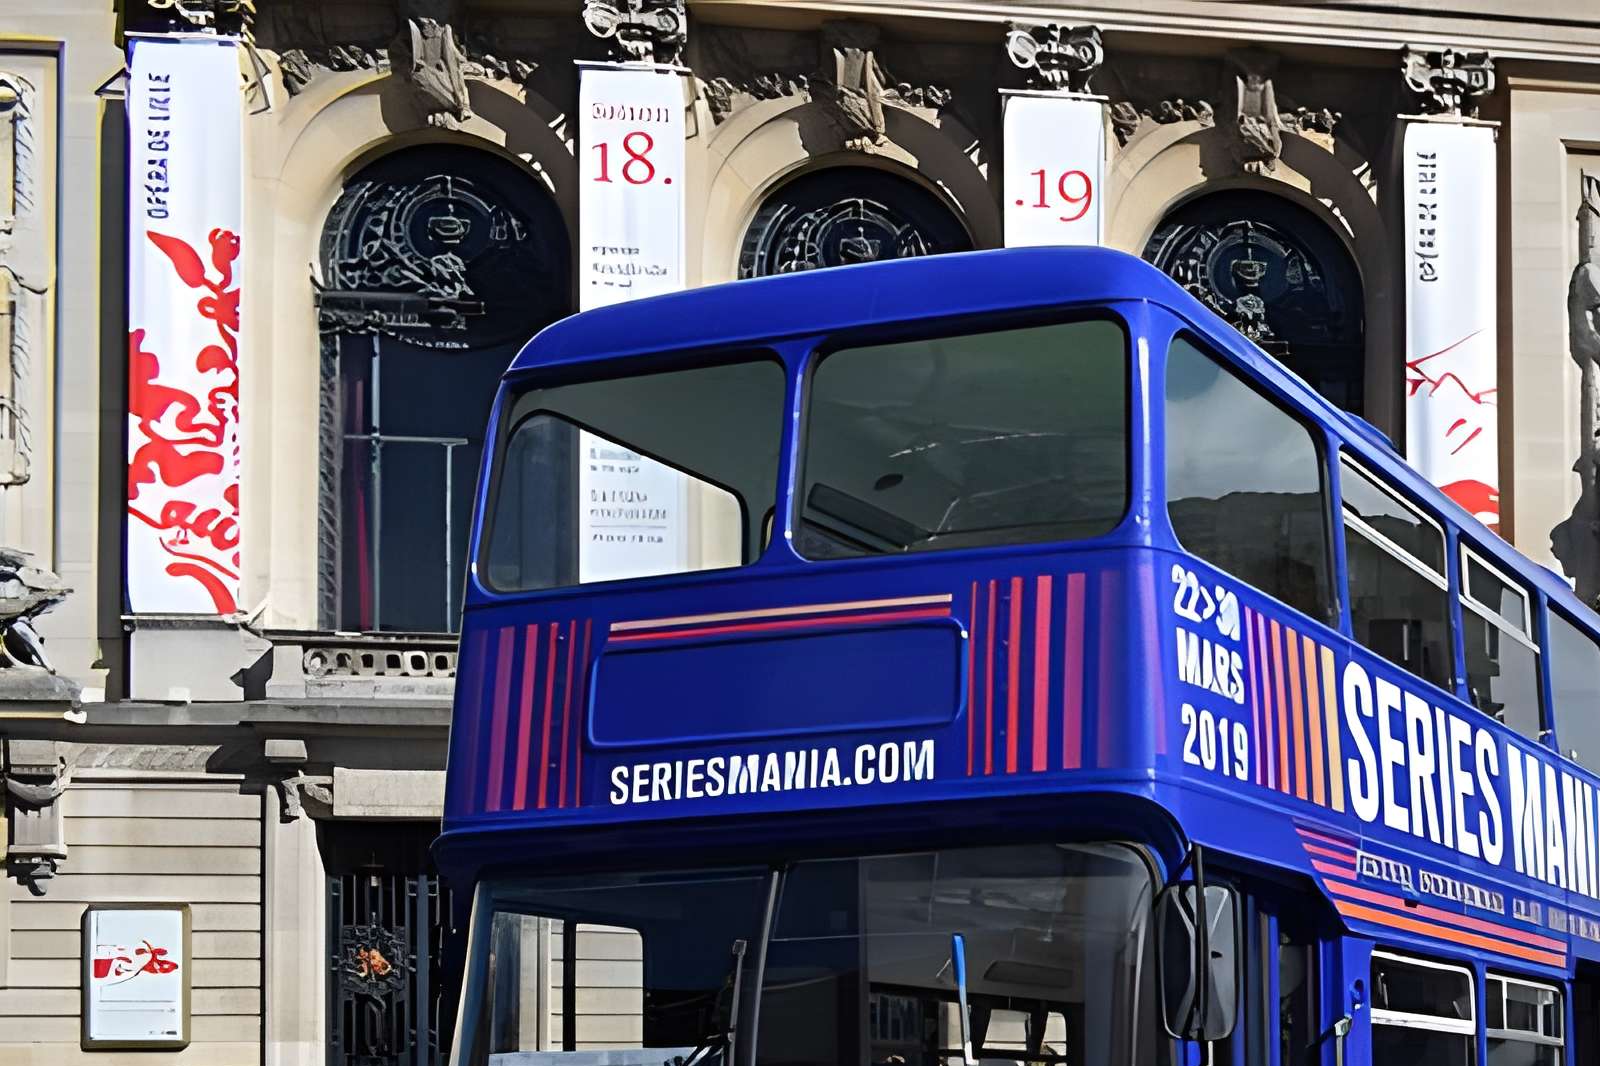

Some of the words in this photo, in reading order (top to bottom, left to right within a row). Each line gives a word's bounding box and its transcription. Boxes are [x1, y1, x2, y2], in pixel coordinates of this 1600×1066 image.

[1175, 626, 1245, 705] MARS
[609, 738, 936, 806] SERIESMANIA.COM
[1181, 703, 1249, 782] 2019
[1342, 660, 1504, 867] SERIES
